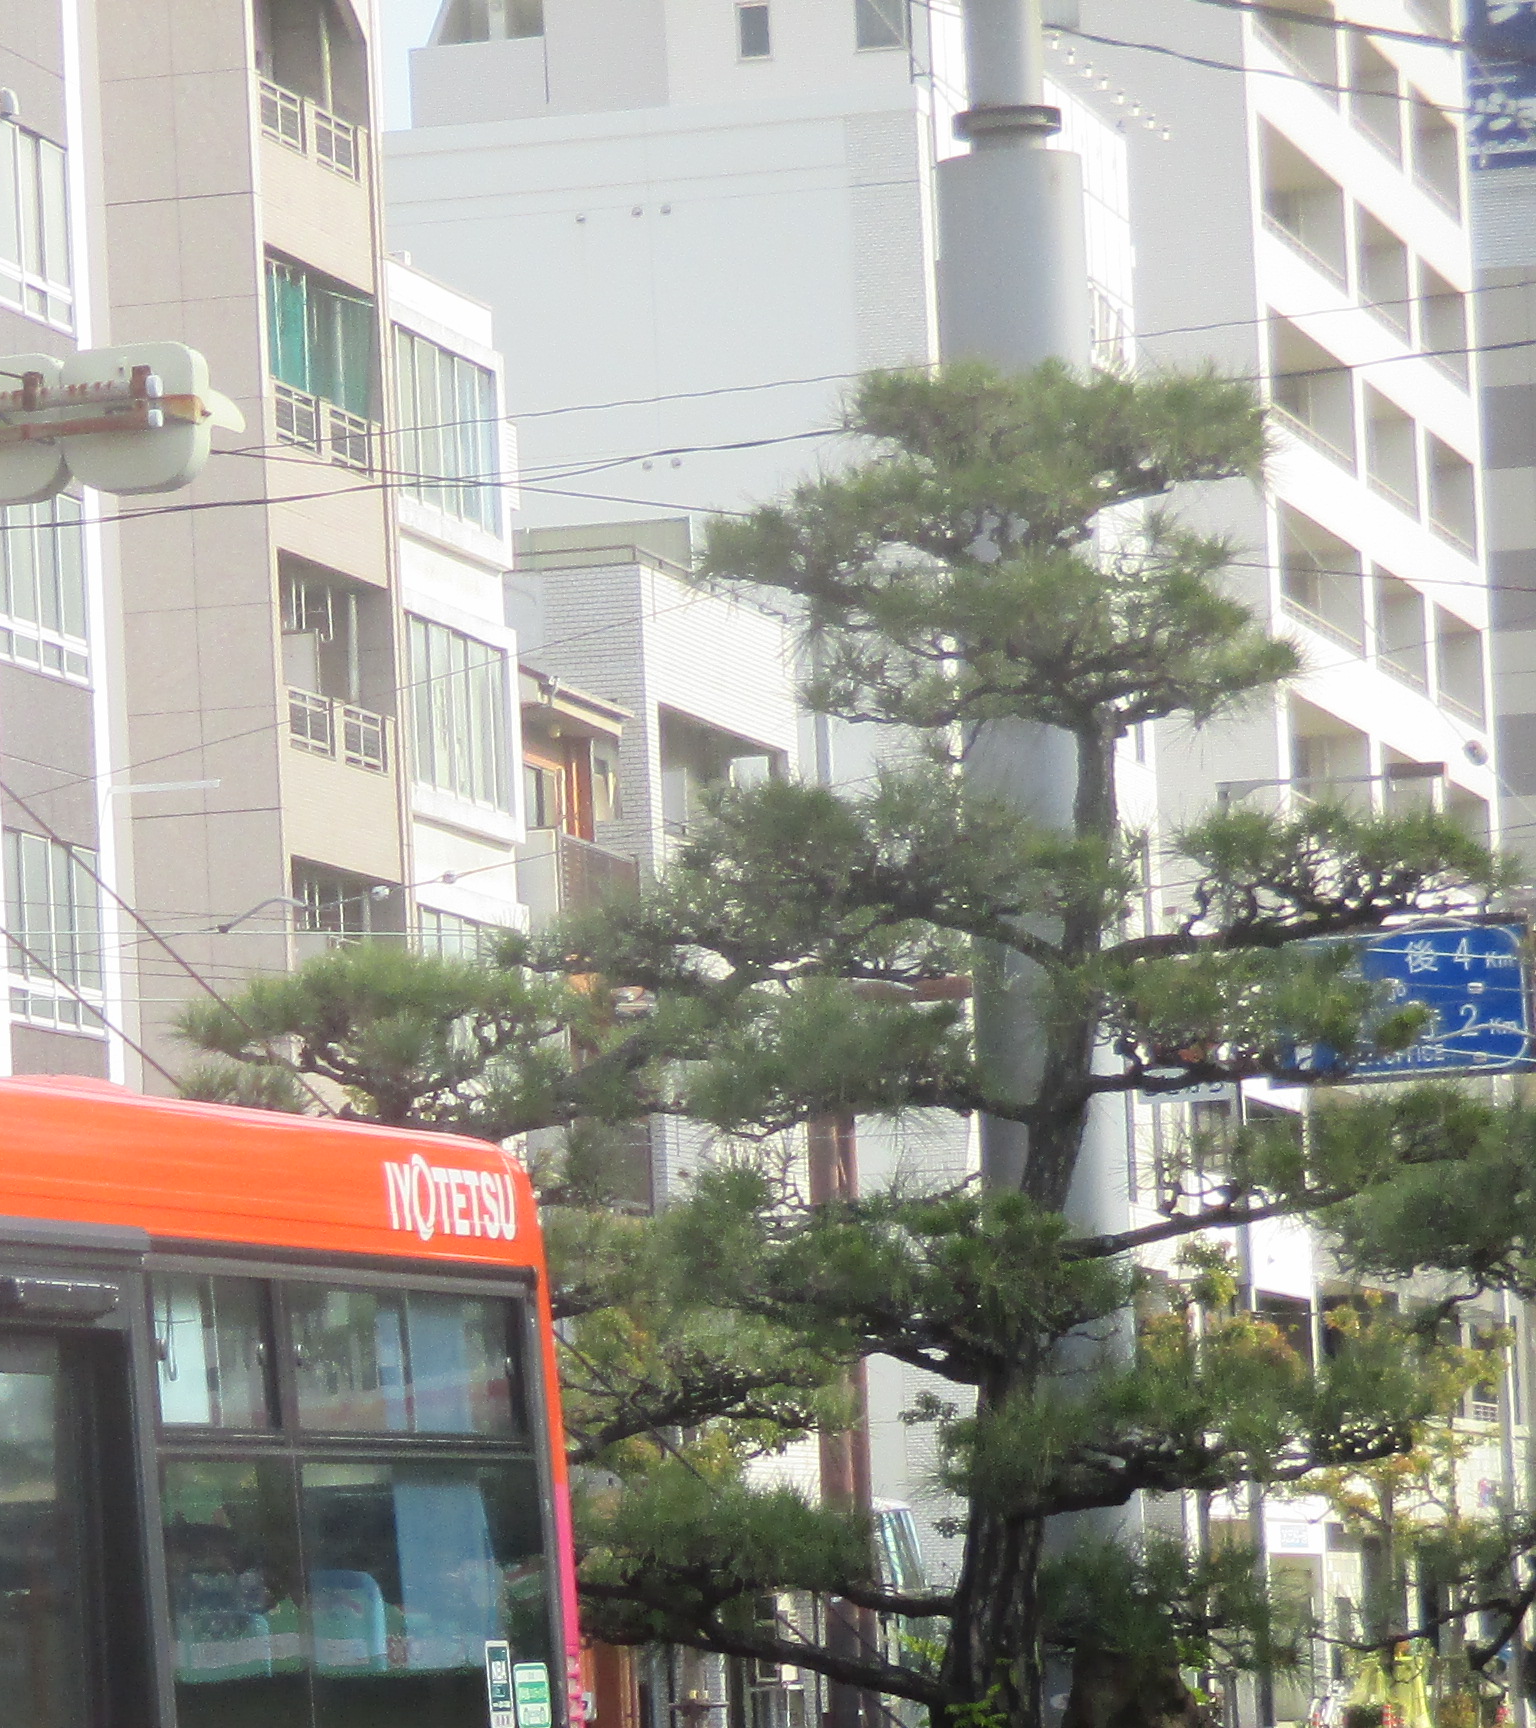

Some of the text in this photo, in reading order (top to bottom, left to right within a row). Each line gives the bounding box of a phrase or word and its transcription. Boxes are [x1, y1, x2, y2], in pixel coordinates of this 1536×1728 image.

[1453, 937, 1474, 970] 4
[1459, 1003, 1478, 1037] 2
[384, 1153, 517, 1241] IYOTETSU
